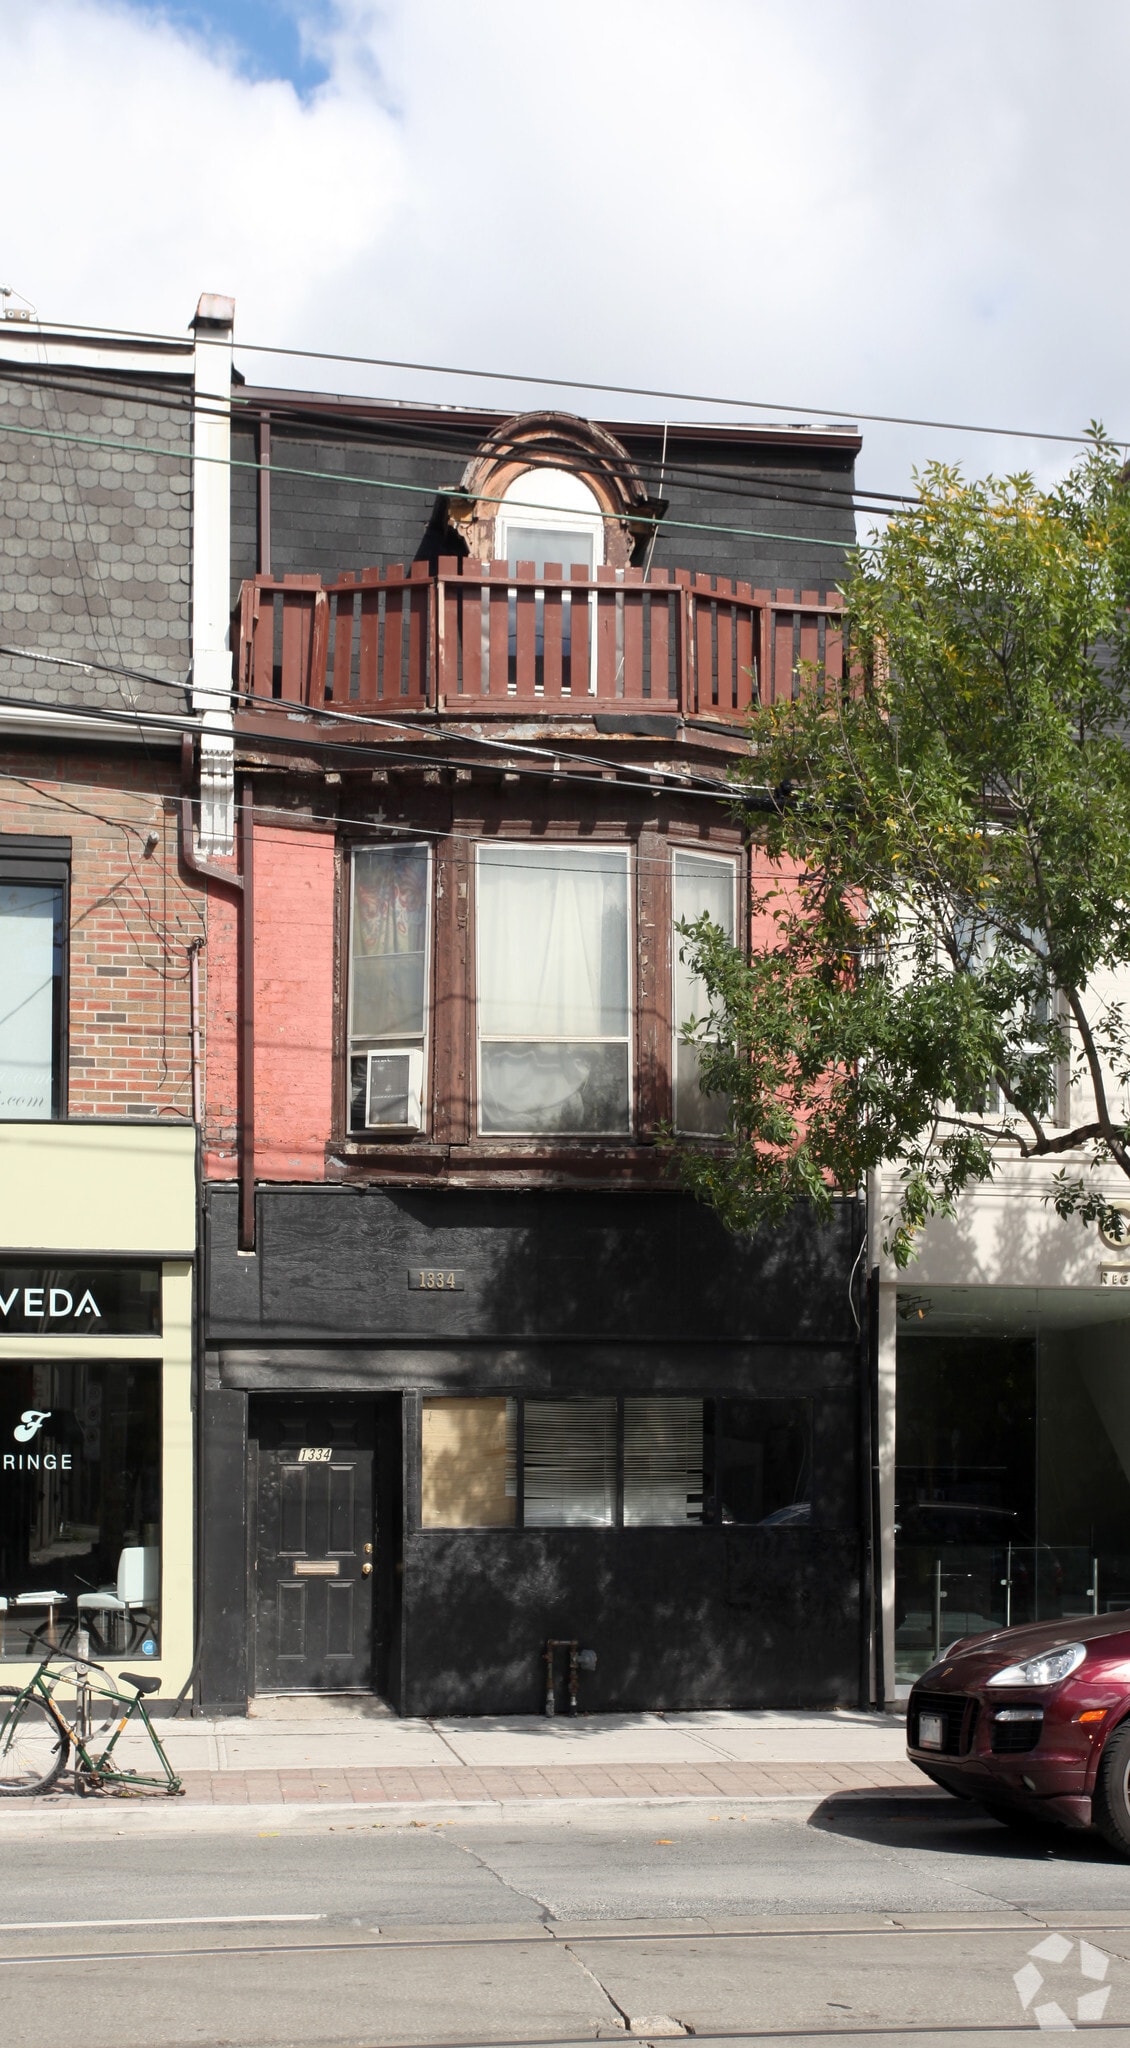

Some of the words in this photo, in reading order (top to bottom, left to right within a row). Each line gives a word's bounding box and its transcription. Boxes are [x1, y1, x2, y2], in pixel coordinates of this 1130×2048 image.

[419, 1271, 456, 1289] 1334
[3, 1454, 73, 1470] RINGE
[301, 1448, 331, 1461] 1334
